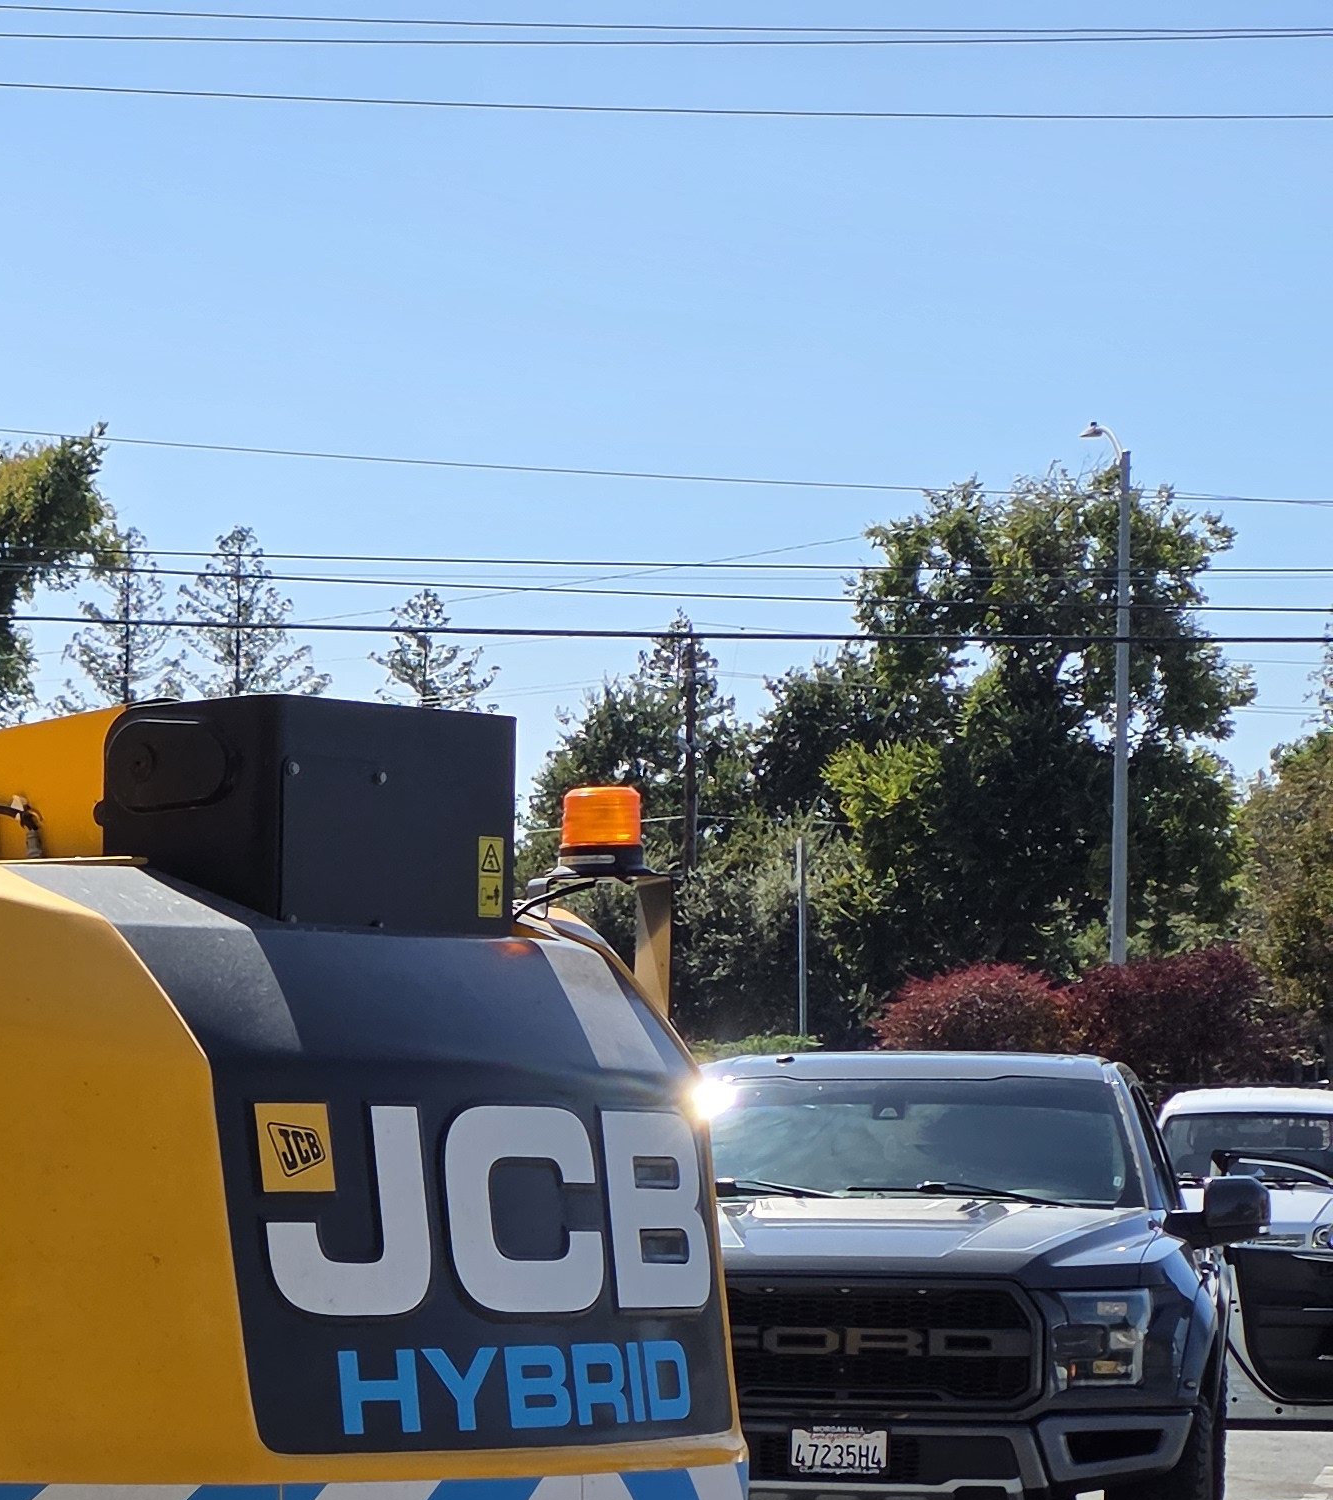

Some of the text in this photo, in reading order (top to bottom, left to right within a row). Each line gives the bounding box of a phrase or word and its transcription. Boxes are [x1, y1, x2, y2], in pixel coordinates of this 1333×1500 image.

[280, 1129, 322, 1171] JCB
[266, 1105, 711, 1316] JCB
[337, 1340, 691, 1435] HYBRID
[795, 1443, 882, 1469] 47235H4
